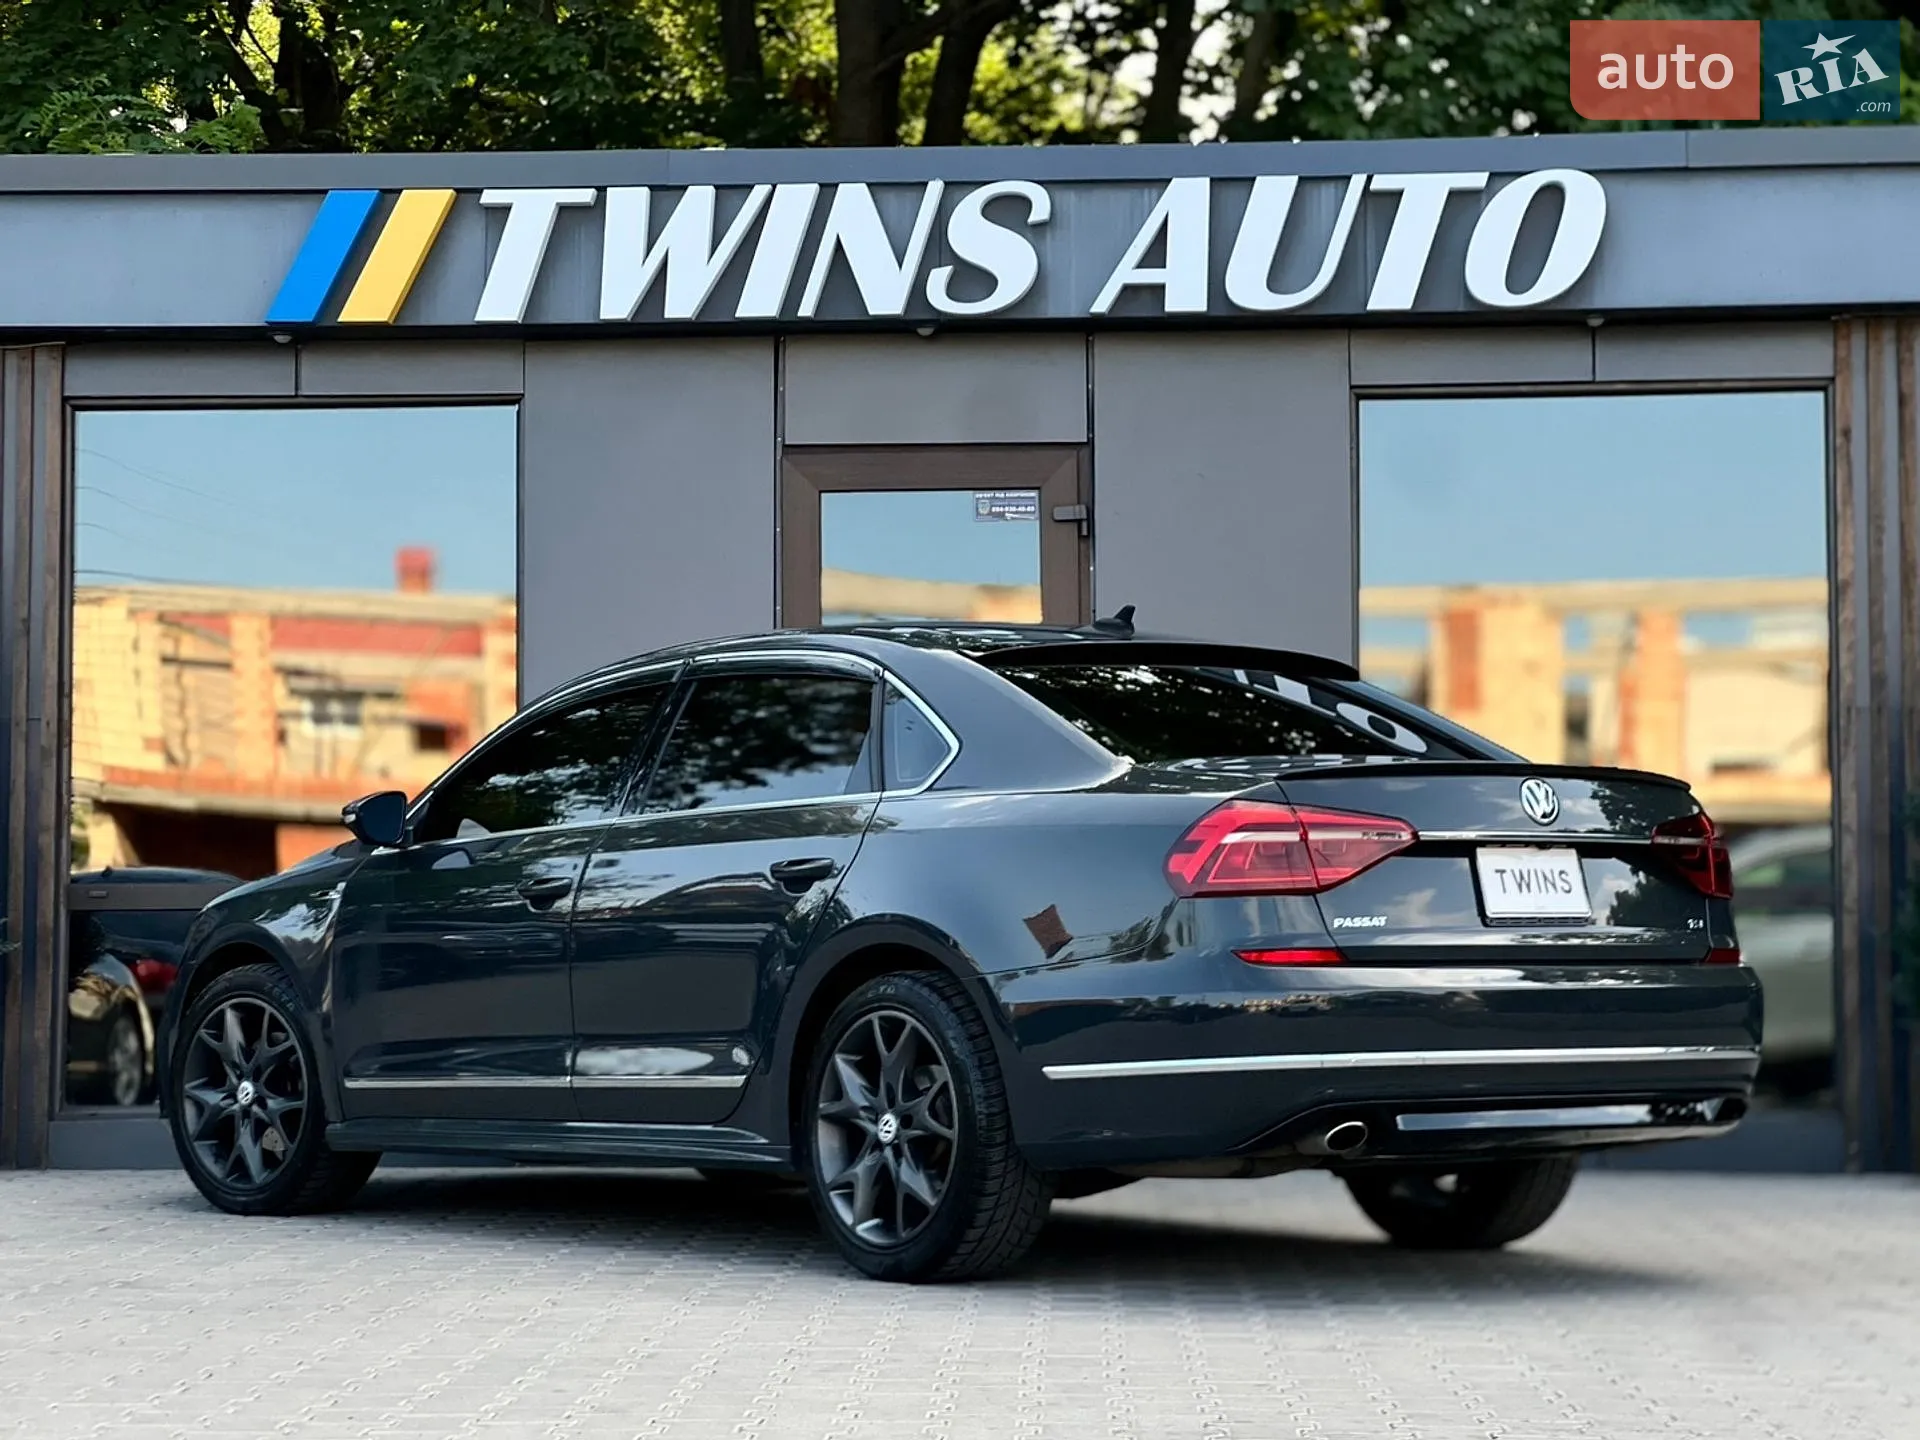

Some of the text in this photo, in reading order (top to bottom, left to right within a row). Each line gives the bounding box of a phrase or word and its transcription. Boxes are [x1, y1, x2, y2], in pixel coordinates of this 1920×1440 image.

[474, 168, 1607, 323] TWINS AUTO
[1494, 868, 1573, 895] TWINS
[1333, 915, 1388, 929] PASSAT
